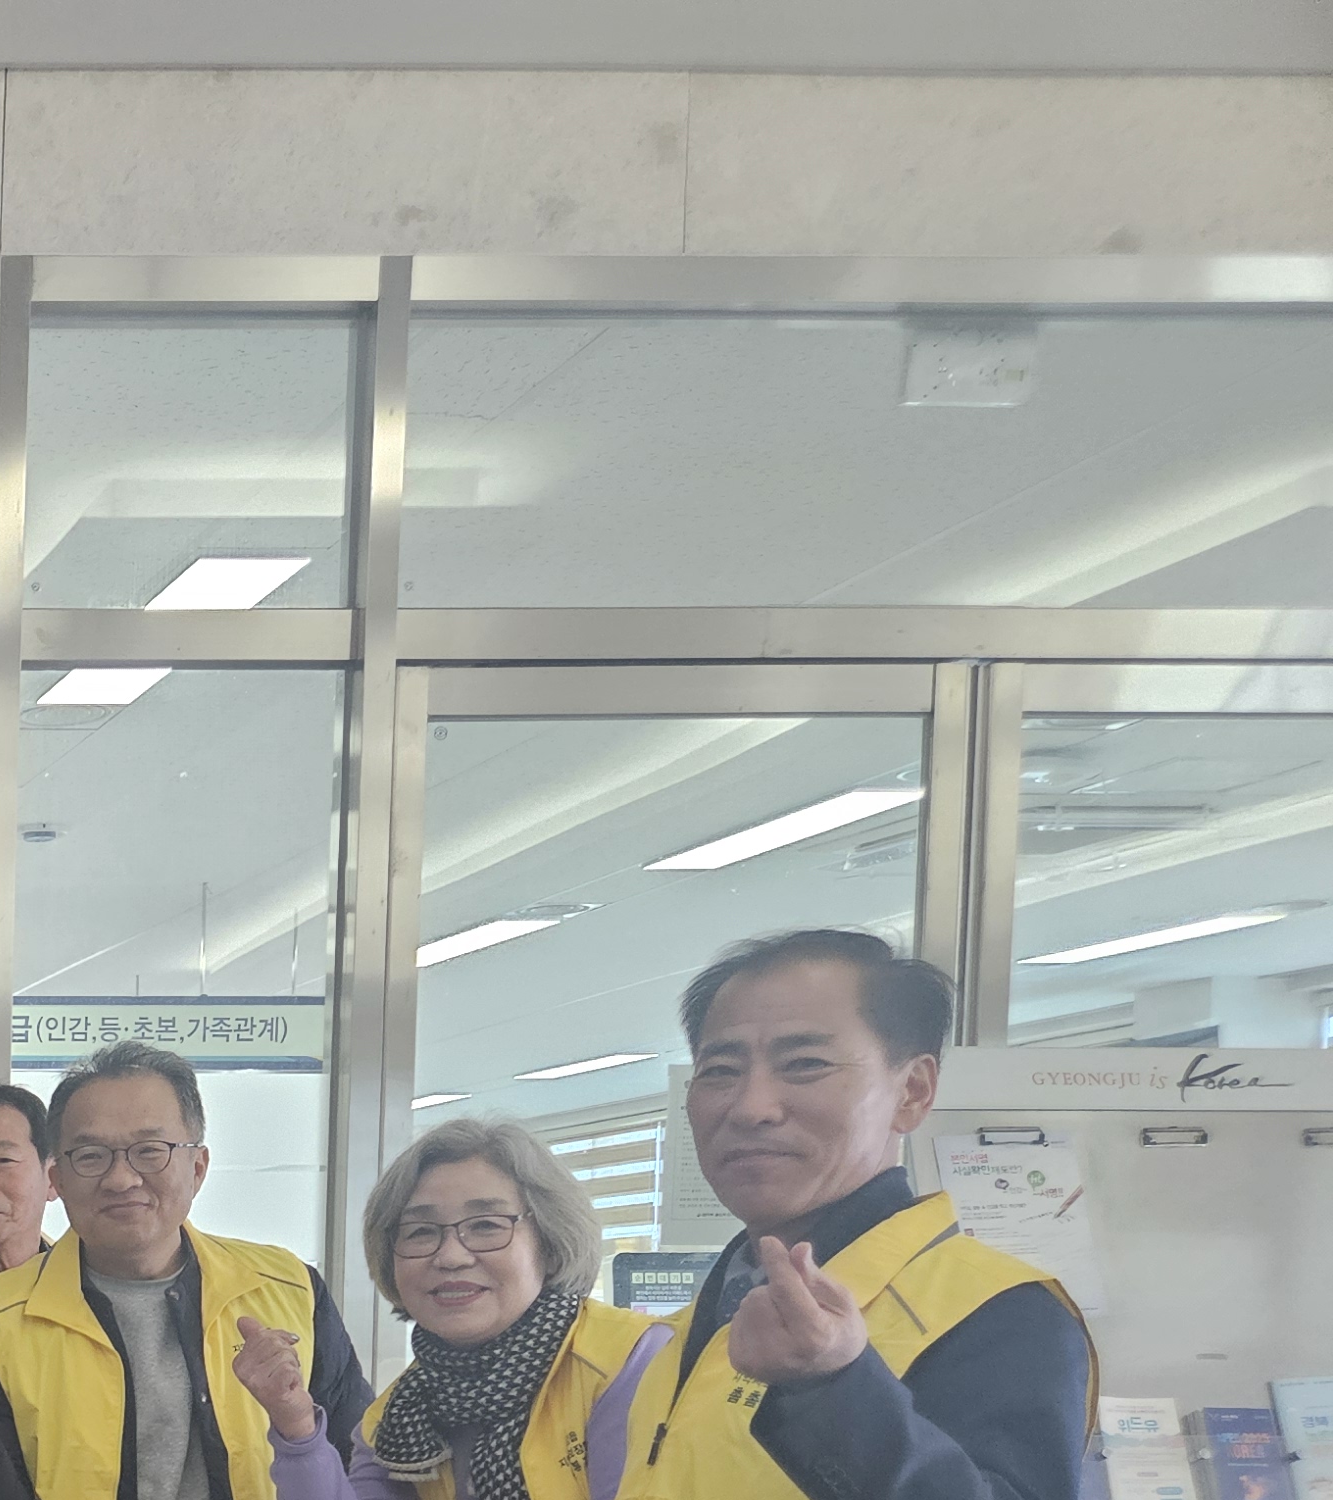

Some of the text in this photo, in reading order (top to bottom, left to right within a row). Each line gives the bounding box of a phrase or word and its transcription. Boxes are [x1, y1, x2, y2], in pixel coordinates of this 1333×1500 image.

[1032, 1053, 1294, 1102] GYEONGJU is Korea
